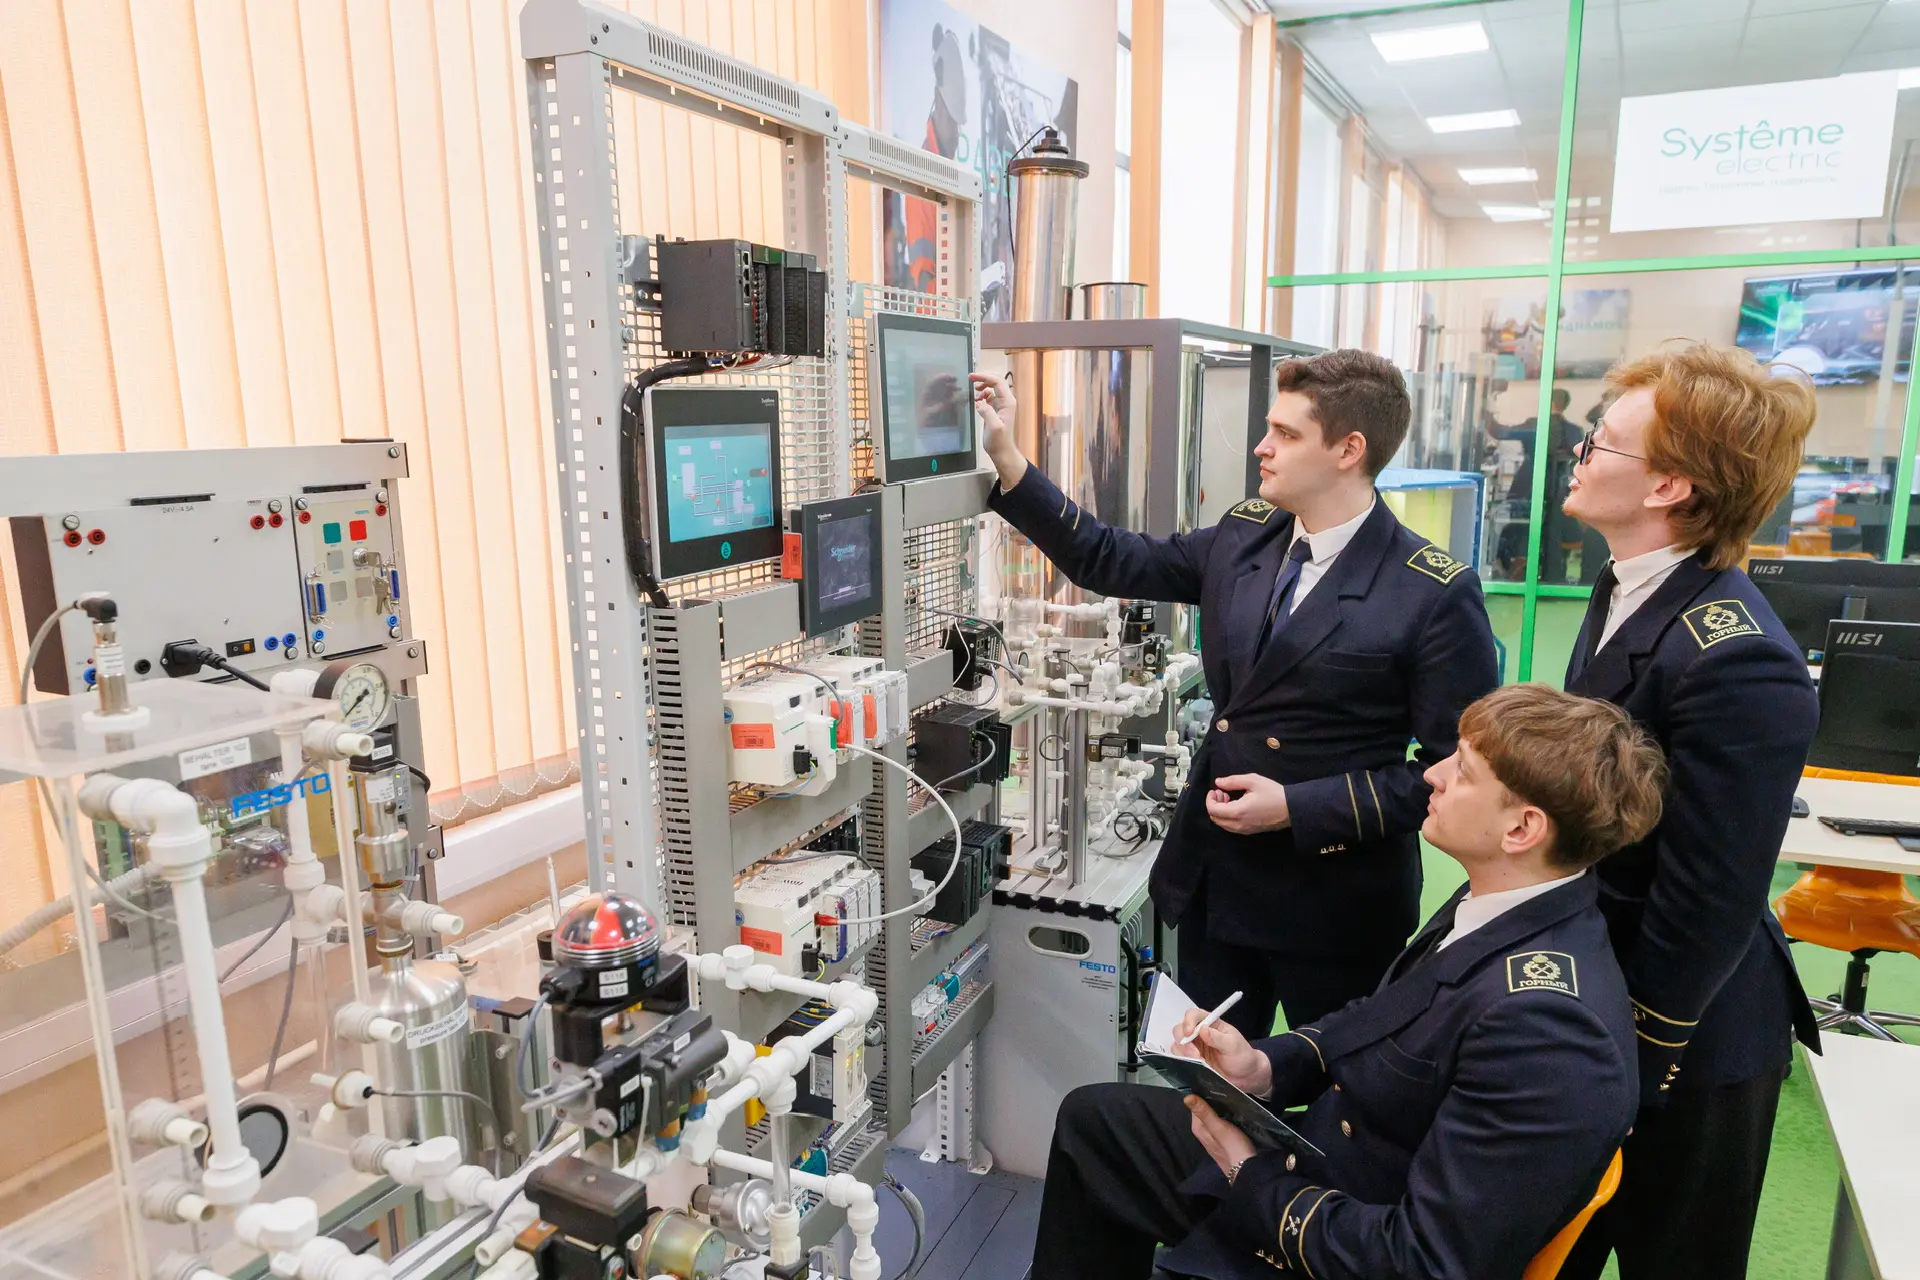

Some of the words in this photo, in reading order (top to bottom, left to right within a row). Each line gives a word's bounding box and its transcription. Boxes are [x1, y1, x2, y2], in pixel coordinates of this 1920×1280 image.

[1716, 151, 1841, 175] electric
[1752, 565, 1785, 575] MSI
[1706, 623, 1752, 641] ГОРНЫЙ
[1835, 632, 1884, 646] MSI
[231, 772, 331, 818] FESTO
[1080, 961, 1116, 974] FESTO
[1519, 979, 1568, 990] ГОРНЫЙ
